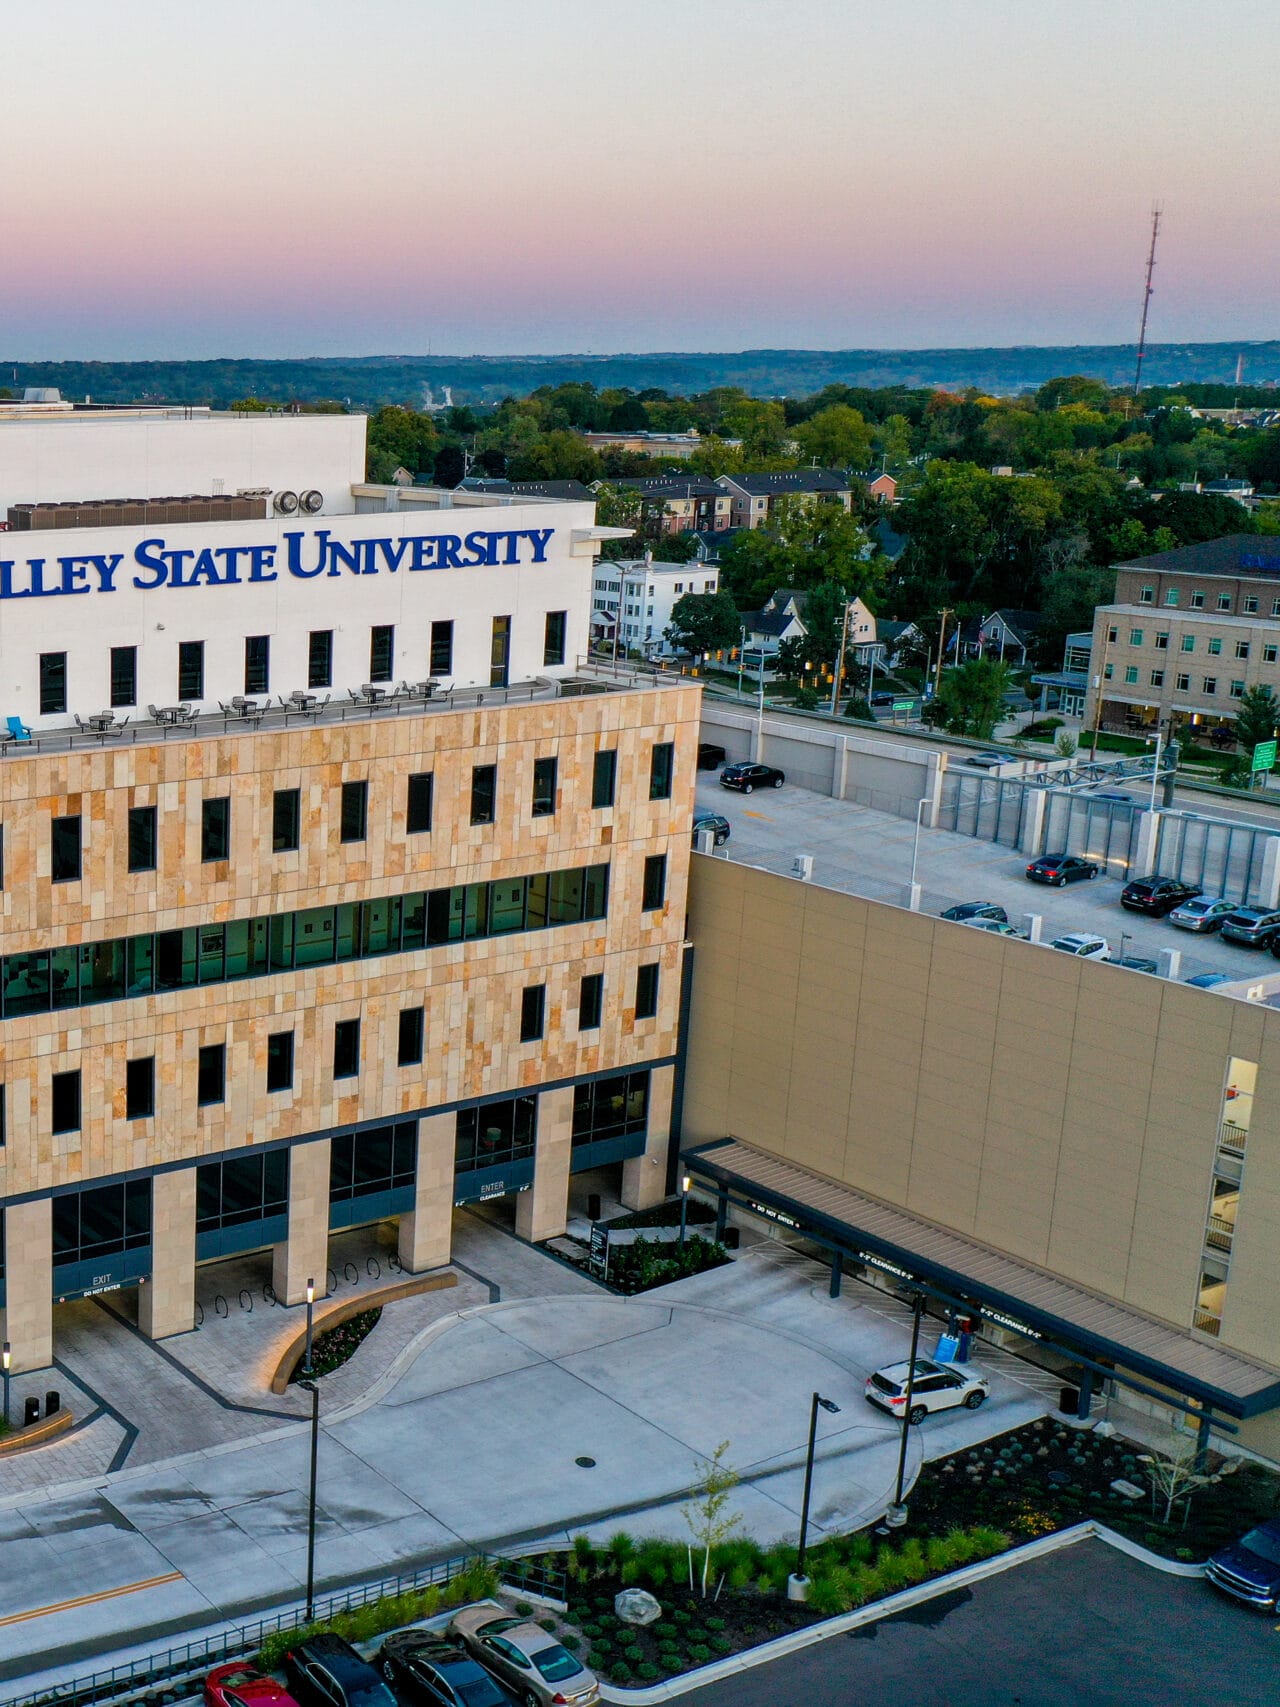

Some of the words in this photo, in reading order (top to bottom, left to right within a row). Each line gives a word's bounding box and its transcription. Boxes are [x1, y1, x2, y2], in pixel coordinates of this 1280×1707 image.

[133, 538, 277, 589] STATE
[283, 528, 555, 578] UNIVERSITY
[481, 1181, 504, 1193] ENTER
[766, 1210, 777, 1218] NOT
[777, 1215, 794, 1226] ENTER
[871, 1257, 901, 1275] CLEARANCE
[92, 1273, 112, 1286] EXIT
[103, 1284, 121, 1292] ENTER
[993, 1313, 1028, 1333] CLEARANCE
